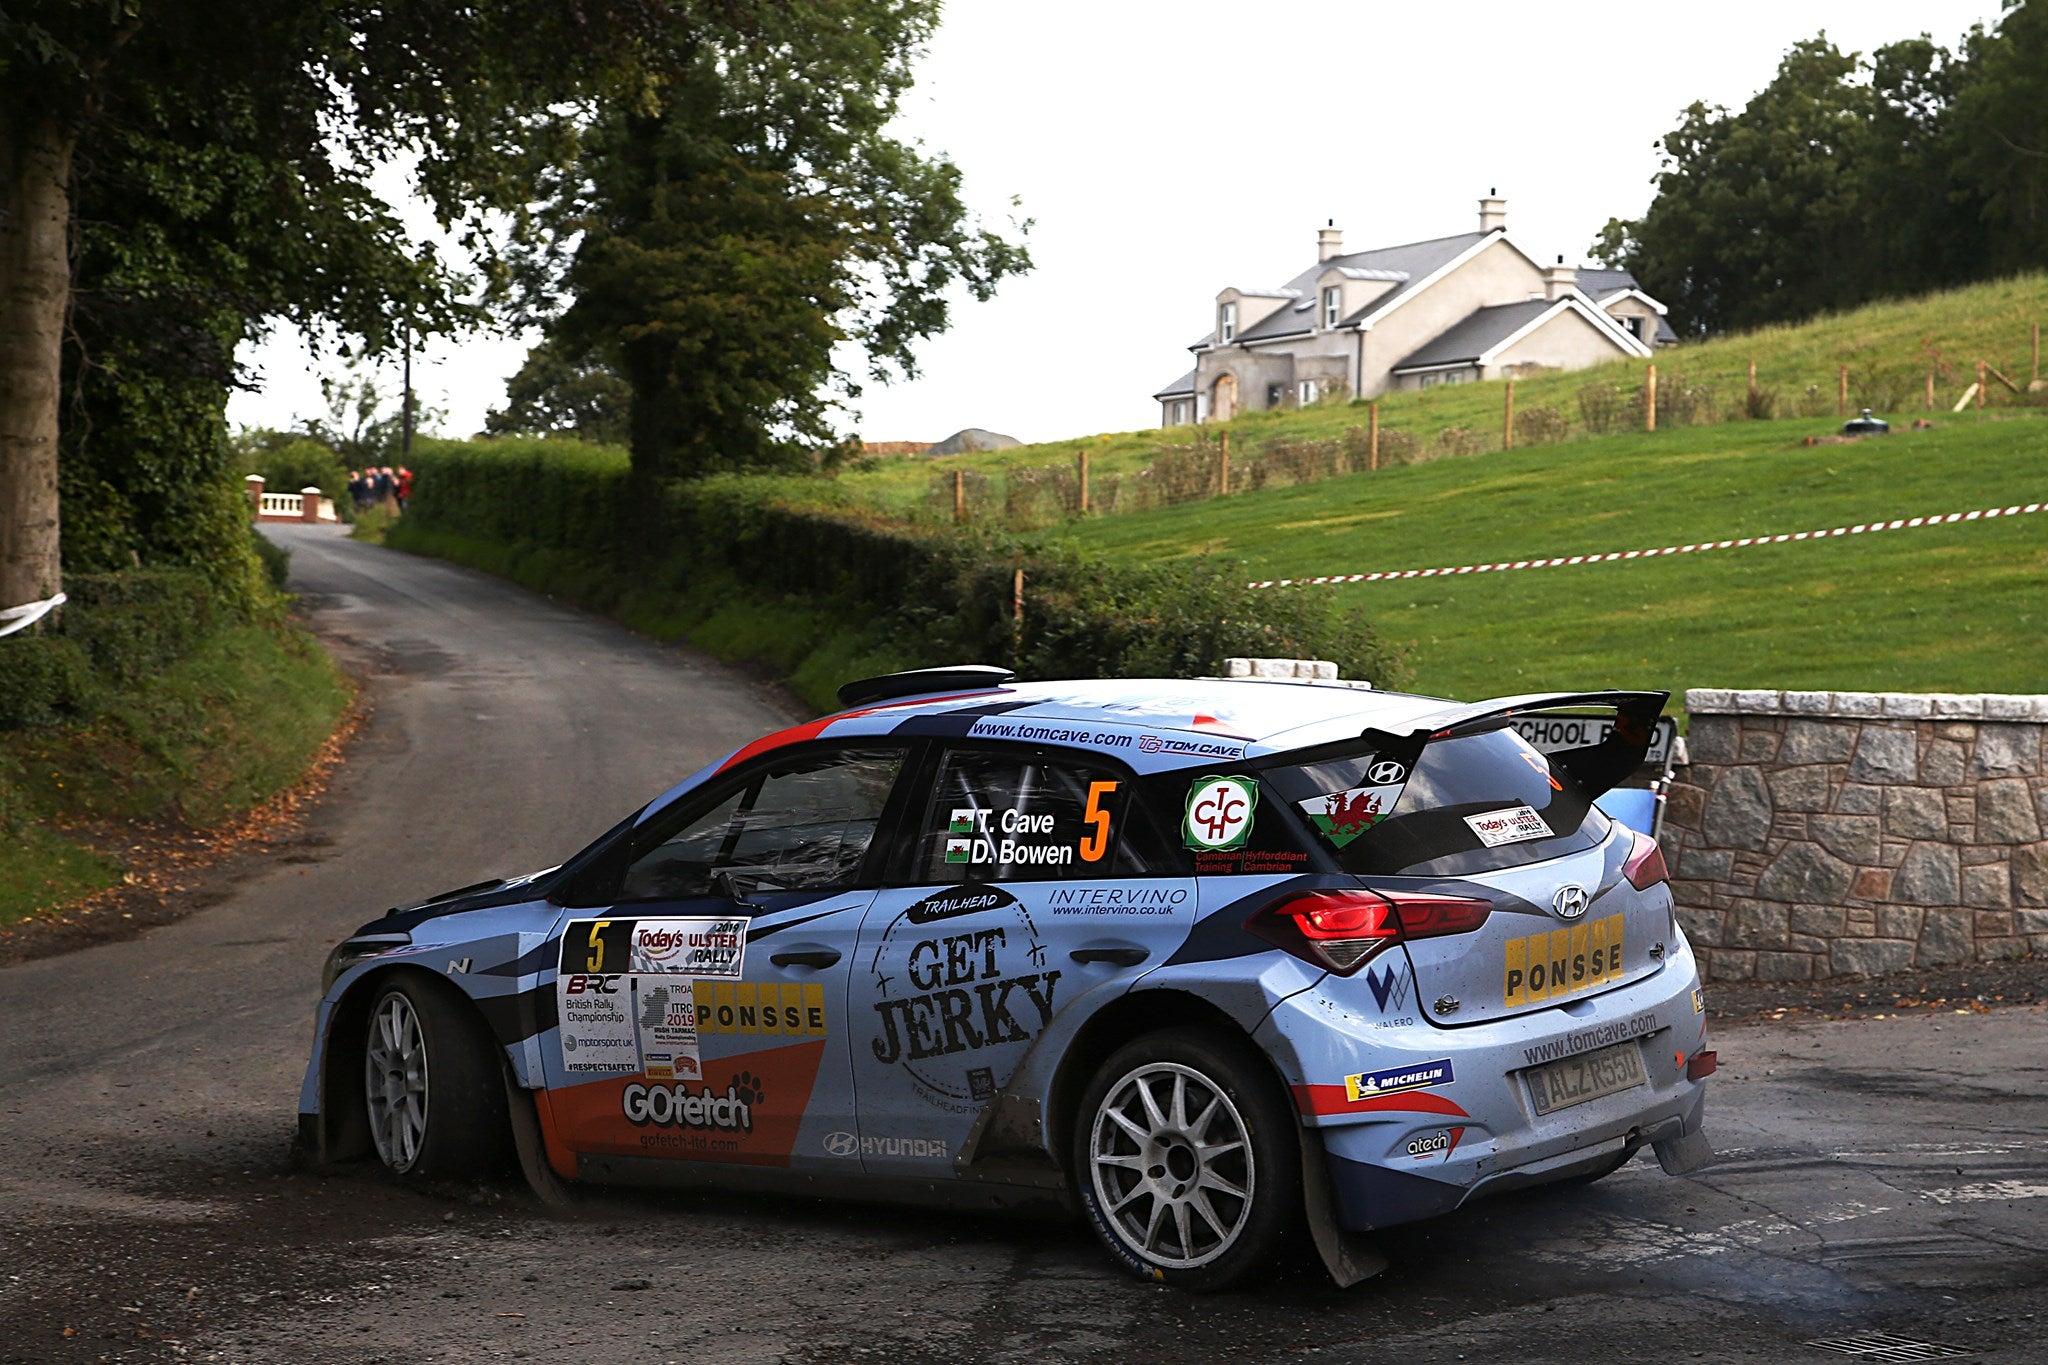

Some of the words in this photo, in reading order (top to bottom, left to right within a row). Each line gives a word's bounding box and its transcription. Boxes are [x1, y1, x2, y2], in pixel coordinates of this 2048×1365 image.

[972, 722, 1133, 748] www.tomcave.com
[1164, 740, 1198, 752] TOM
[1198, 743, 1242, 757] CAVE
[977, 808, 995, 833] T.
[1001, 808, 1055, 834] Cave
[1079, 781, 1118, 862] 5
[1508, 815, 1538, 826] ULSTER
[1517, 822, 1543, 832] RALLY
[972, 839, 993, 864] D.
[999, 839, 1073, 865] Bowen
[1244, 862, 1292, 872] Cambrian
[923, 894, 998, 915] TRAILHEAD
[1048, 889, 1188, 905] INTERVINO
[1052, 904, 1175, 917] www.intervino.co.uk
[716, 923, 740, 933] 2019
[586, 921, 611, 973] 5
[638, 928, 684, 952] Today's
[688, 933, 738, 949] ULSTER
[693, 948, 737, 964] RALLY
[908, 927, 1006, 991] GET
[1507, 943, 1621, 997] PONSSE
[566, 975, 622, 995] BRC
[566, 999, 592, 1010] British
[594, 999, 614, 1011] Rally
[672, 1003, 693, 1014] ITRC
[567, 1012, 625, 1023] Championship
[667, 1014, 695, 1026] 2019
[696, 1005, 823, 1028] PONSSE
[871, 970, 1063, 1065] JERKY
[578, 1038, 622, 1049] motorsport
[1524, 1013, 1657, 1065] www.tomcave.com
[568, 1063, 636, 1072] #RESPECTSAFETY
[1380, 1068, 1443, 1088] MICHELIN
[623, 1084, 750, 1128] GOfetch
[860, 1136, 947, 1158] HYUNDAI
[1407, 1131, 1447, 1154] atech
